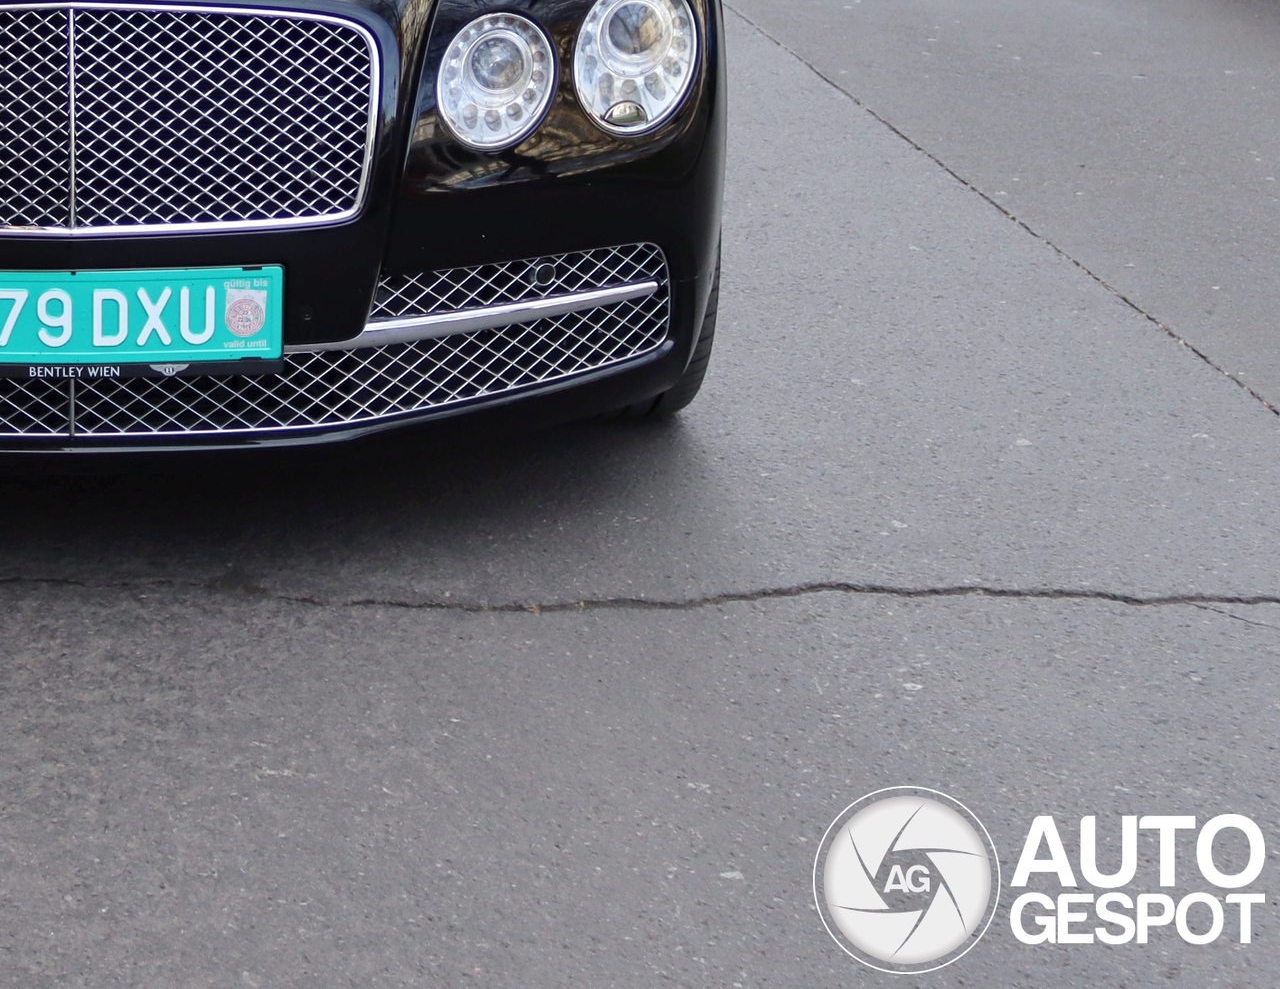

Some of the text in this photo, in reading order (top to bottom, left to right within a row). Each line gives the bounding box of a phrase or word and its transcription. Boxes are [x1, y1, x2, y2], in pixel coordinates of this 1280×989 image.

[224, 278, 268, 290] gültig bis
[93, 286, 215, 347] DXU
[223, 339, 267, 348] valid until
[29, 366, 120, 378] BENTLEY WIEN
